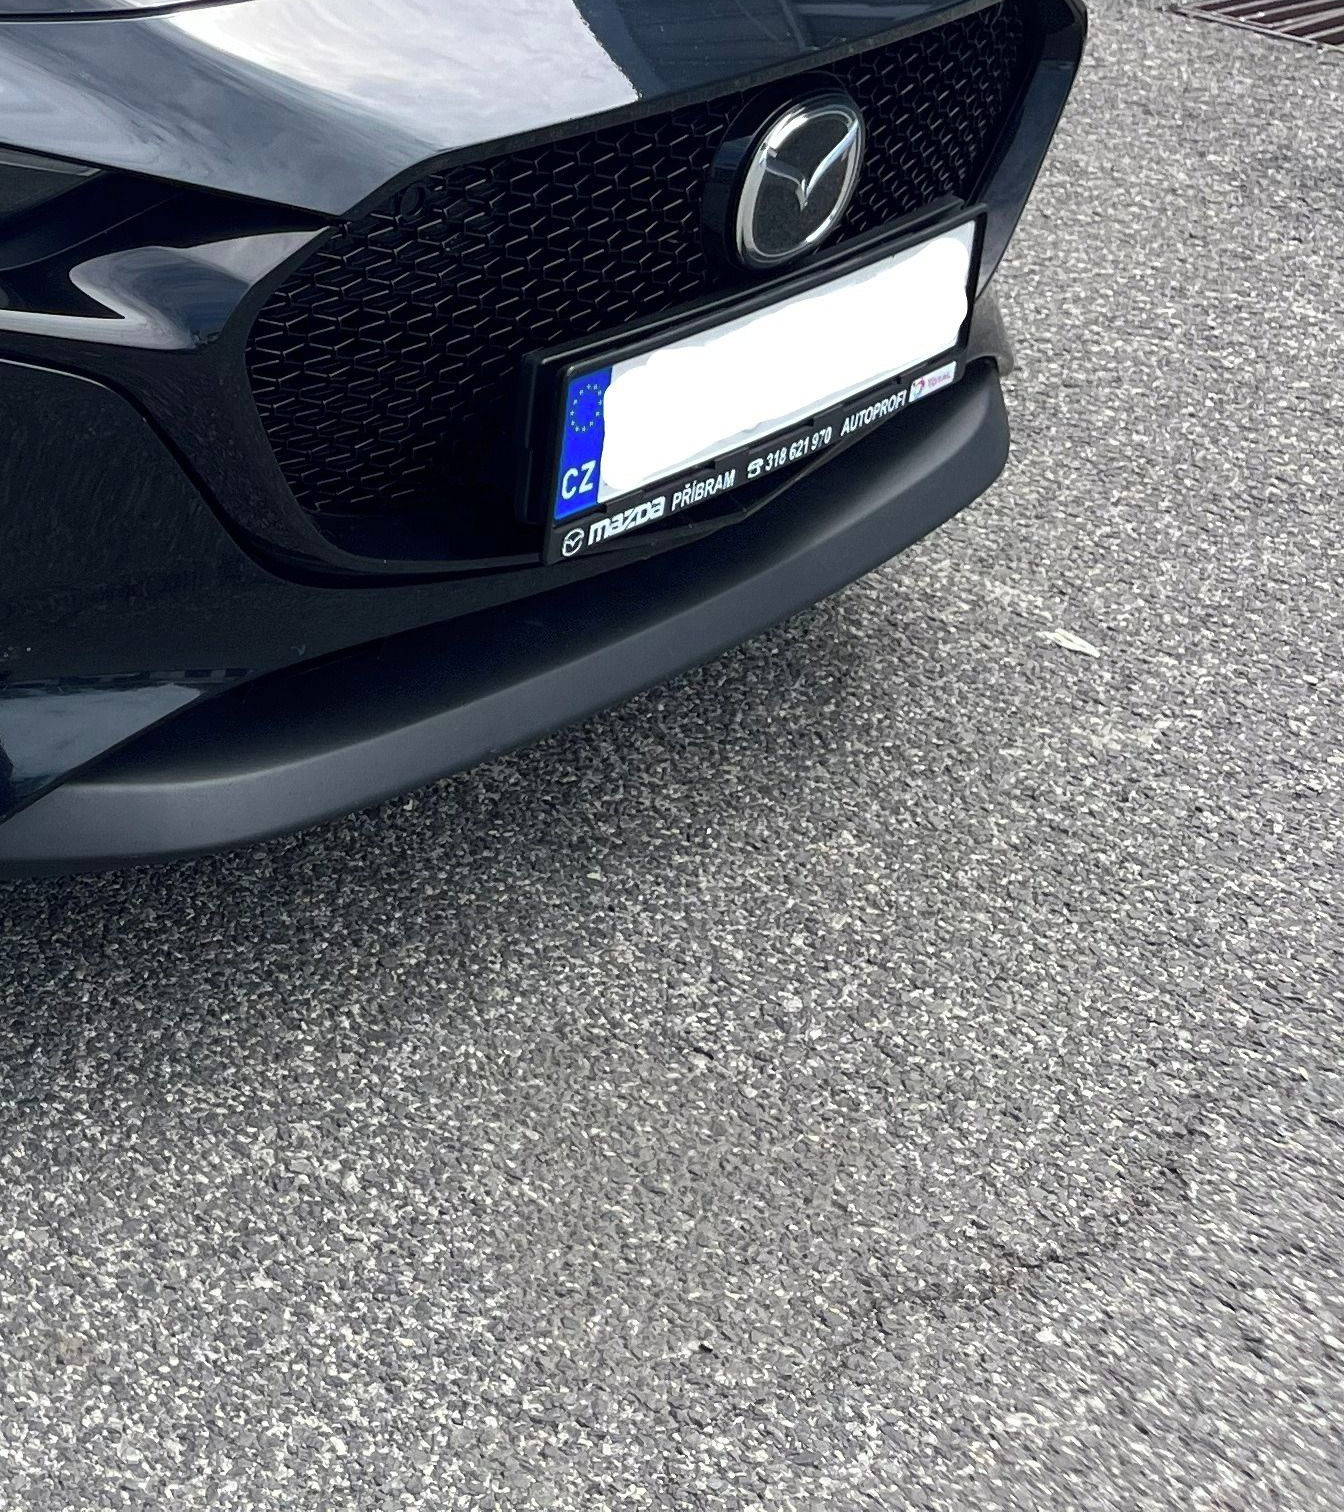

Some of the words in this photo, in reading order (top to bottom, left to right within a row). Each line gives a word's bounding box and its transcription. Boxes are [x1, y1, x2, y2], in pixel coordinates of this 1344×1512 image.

[562, 460, 596, 500] CZ
[671, 469, 736, 512] PŘÍBRAM
[765, 447, 787, 471] 318
[789, 437, 810, 461] 621
[811, 426, 833, 450] 970
[841, 390, 908, 437] AUTOPROFI
